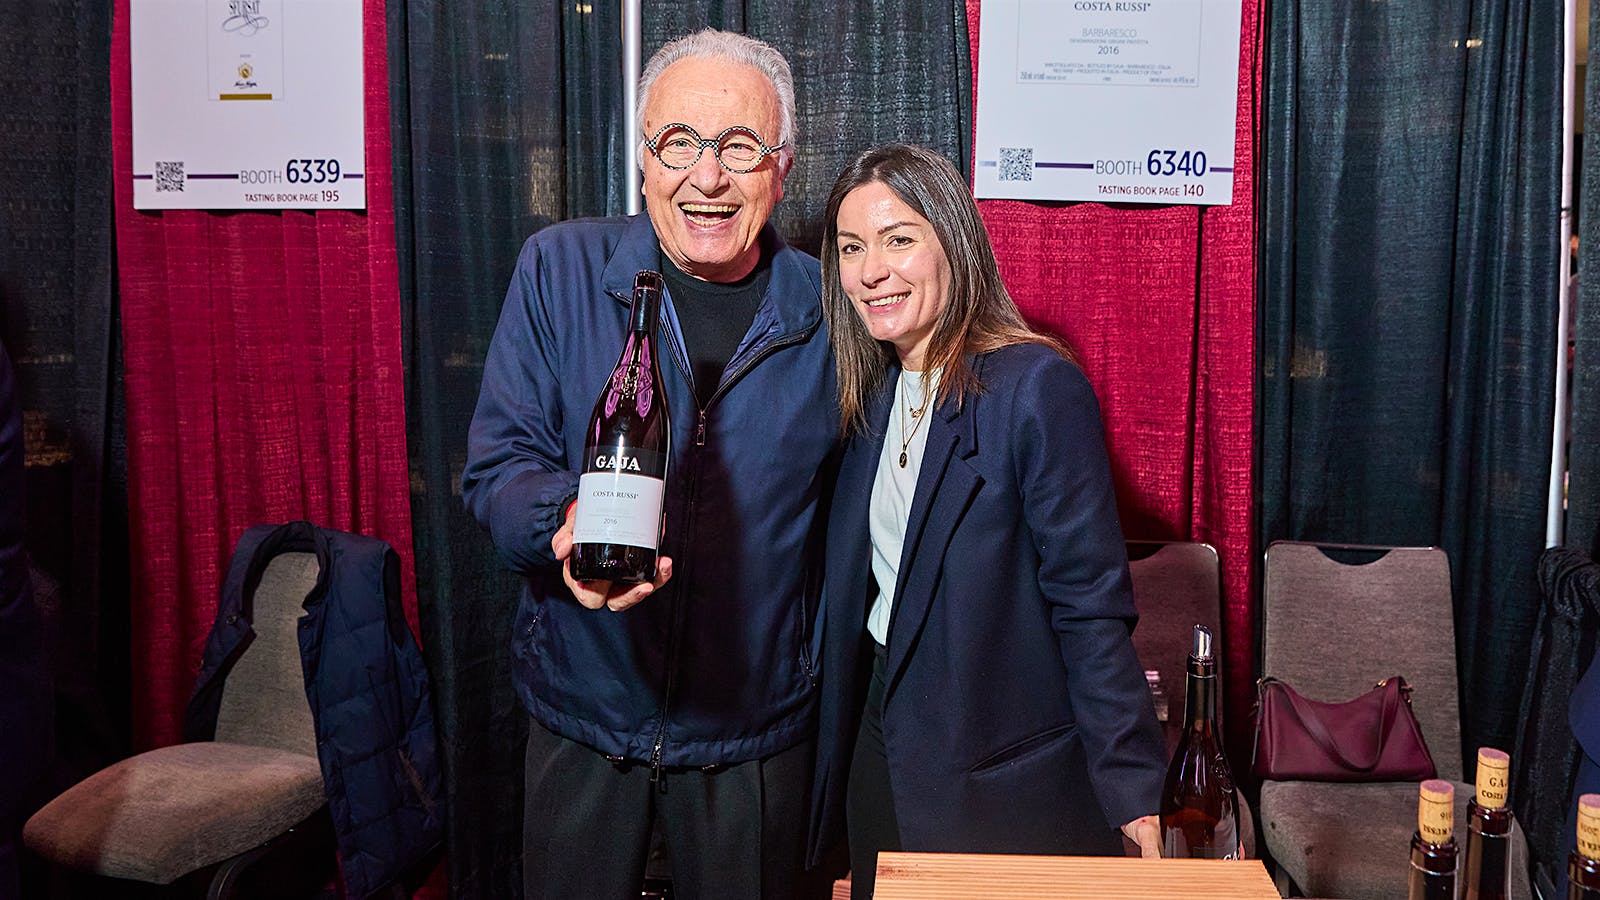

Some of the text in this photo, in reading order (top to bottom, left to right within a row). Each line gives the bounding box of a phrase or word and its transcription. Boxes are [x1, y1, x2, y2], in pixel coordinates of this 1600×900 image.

[1074, 1, 1112, 12] COSTA
[1081, 27, 1138, 38] BARBARESCO
[1097, 45, 1120, 56] 2016
[1096, 149, 1207, 177] BOOTH 6340
[240, 158, 341, 185] BOOTH 6339
[244, 189, 340, 203] TASTING BOOK PAGE 195
[1097, 183, 1205, 197] TASTING BOOK PAGE 140
[595, 455, 641, 471] GAJA
[592, 490, 615, 498] COSTA
[603, 517, 618, 525] 2016
